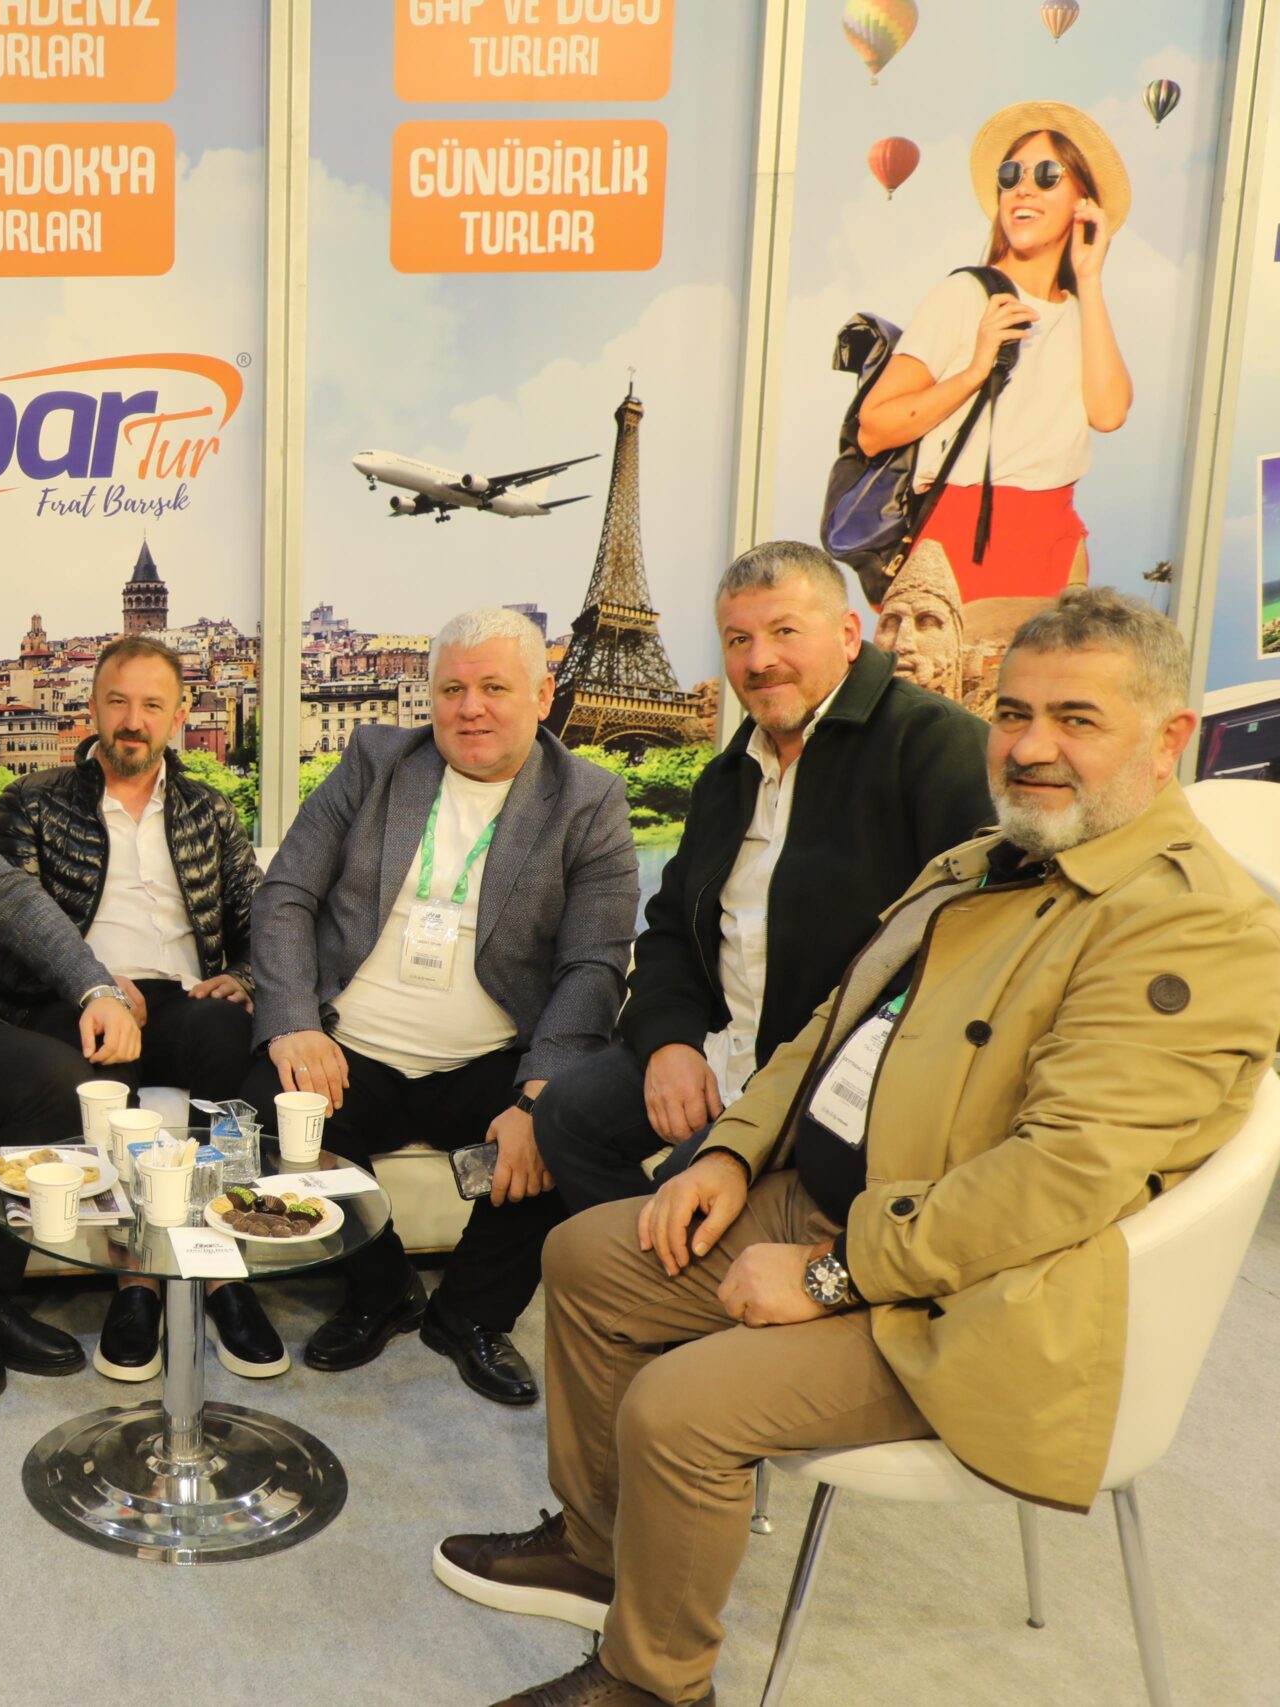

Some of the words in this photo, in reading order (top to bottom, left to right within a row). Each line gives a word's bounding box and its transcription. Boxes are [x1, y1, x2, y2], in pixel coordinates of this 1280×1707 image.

[469, 34, 600, 77] TURLARI
[409, 138, 649, 198] GÜNÜBİRLİK
[459, 209, 595, 255] TURLAR
[123, 405, 220, 480] Tur
